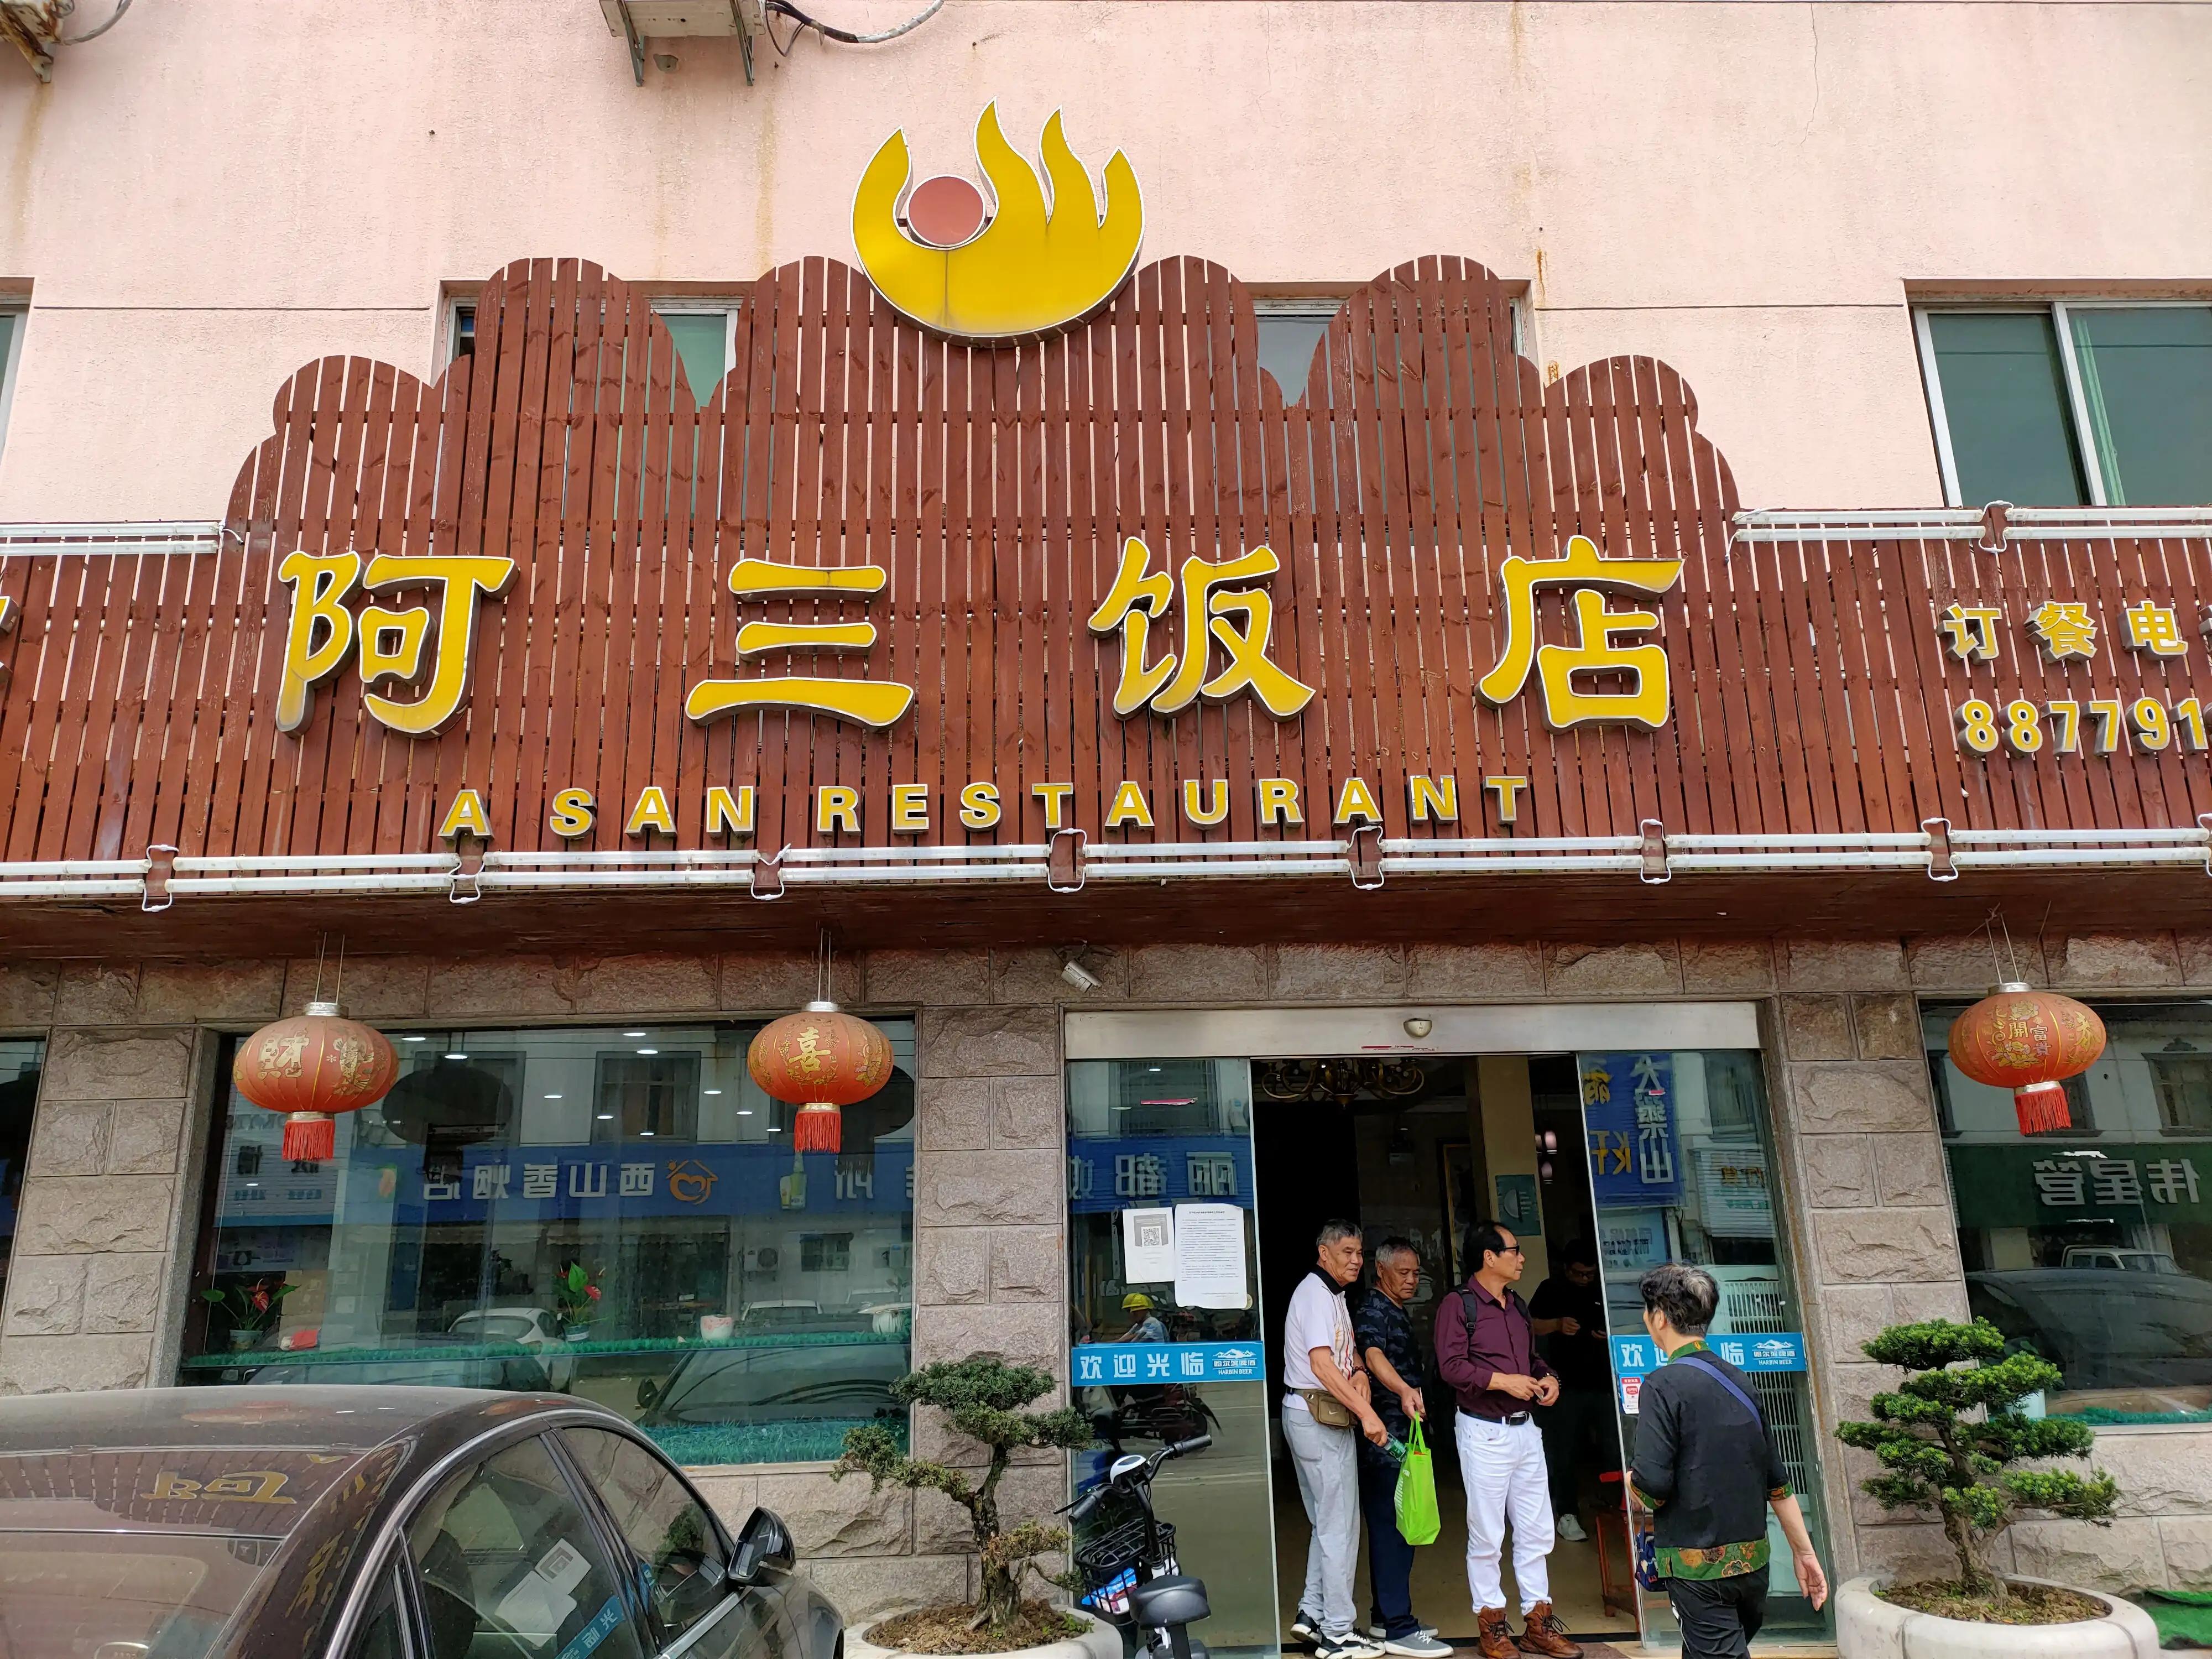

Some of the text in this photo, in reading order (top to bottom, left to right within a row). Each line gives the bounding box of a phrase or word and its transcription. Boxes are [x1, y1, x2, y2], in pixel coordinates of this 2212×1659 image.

[275, 535, 1685, 735] 阿三饭店
[1938, 600, 2212, 662] 订餐电
[1955, 697, 2212, 754] 887791
[437, 775, 1527, 840] A SAN RESTAURANT
[788, 1026, 831, 1073] 喜
[1079, 1352, 1204, 1380] 欢迎光临
